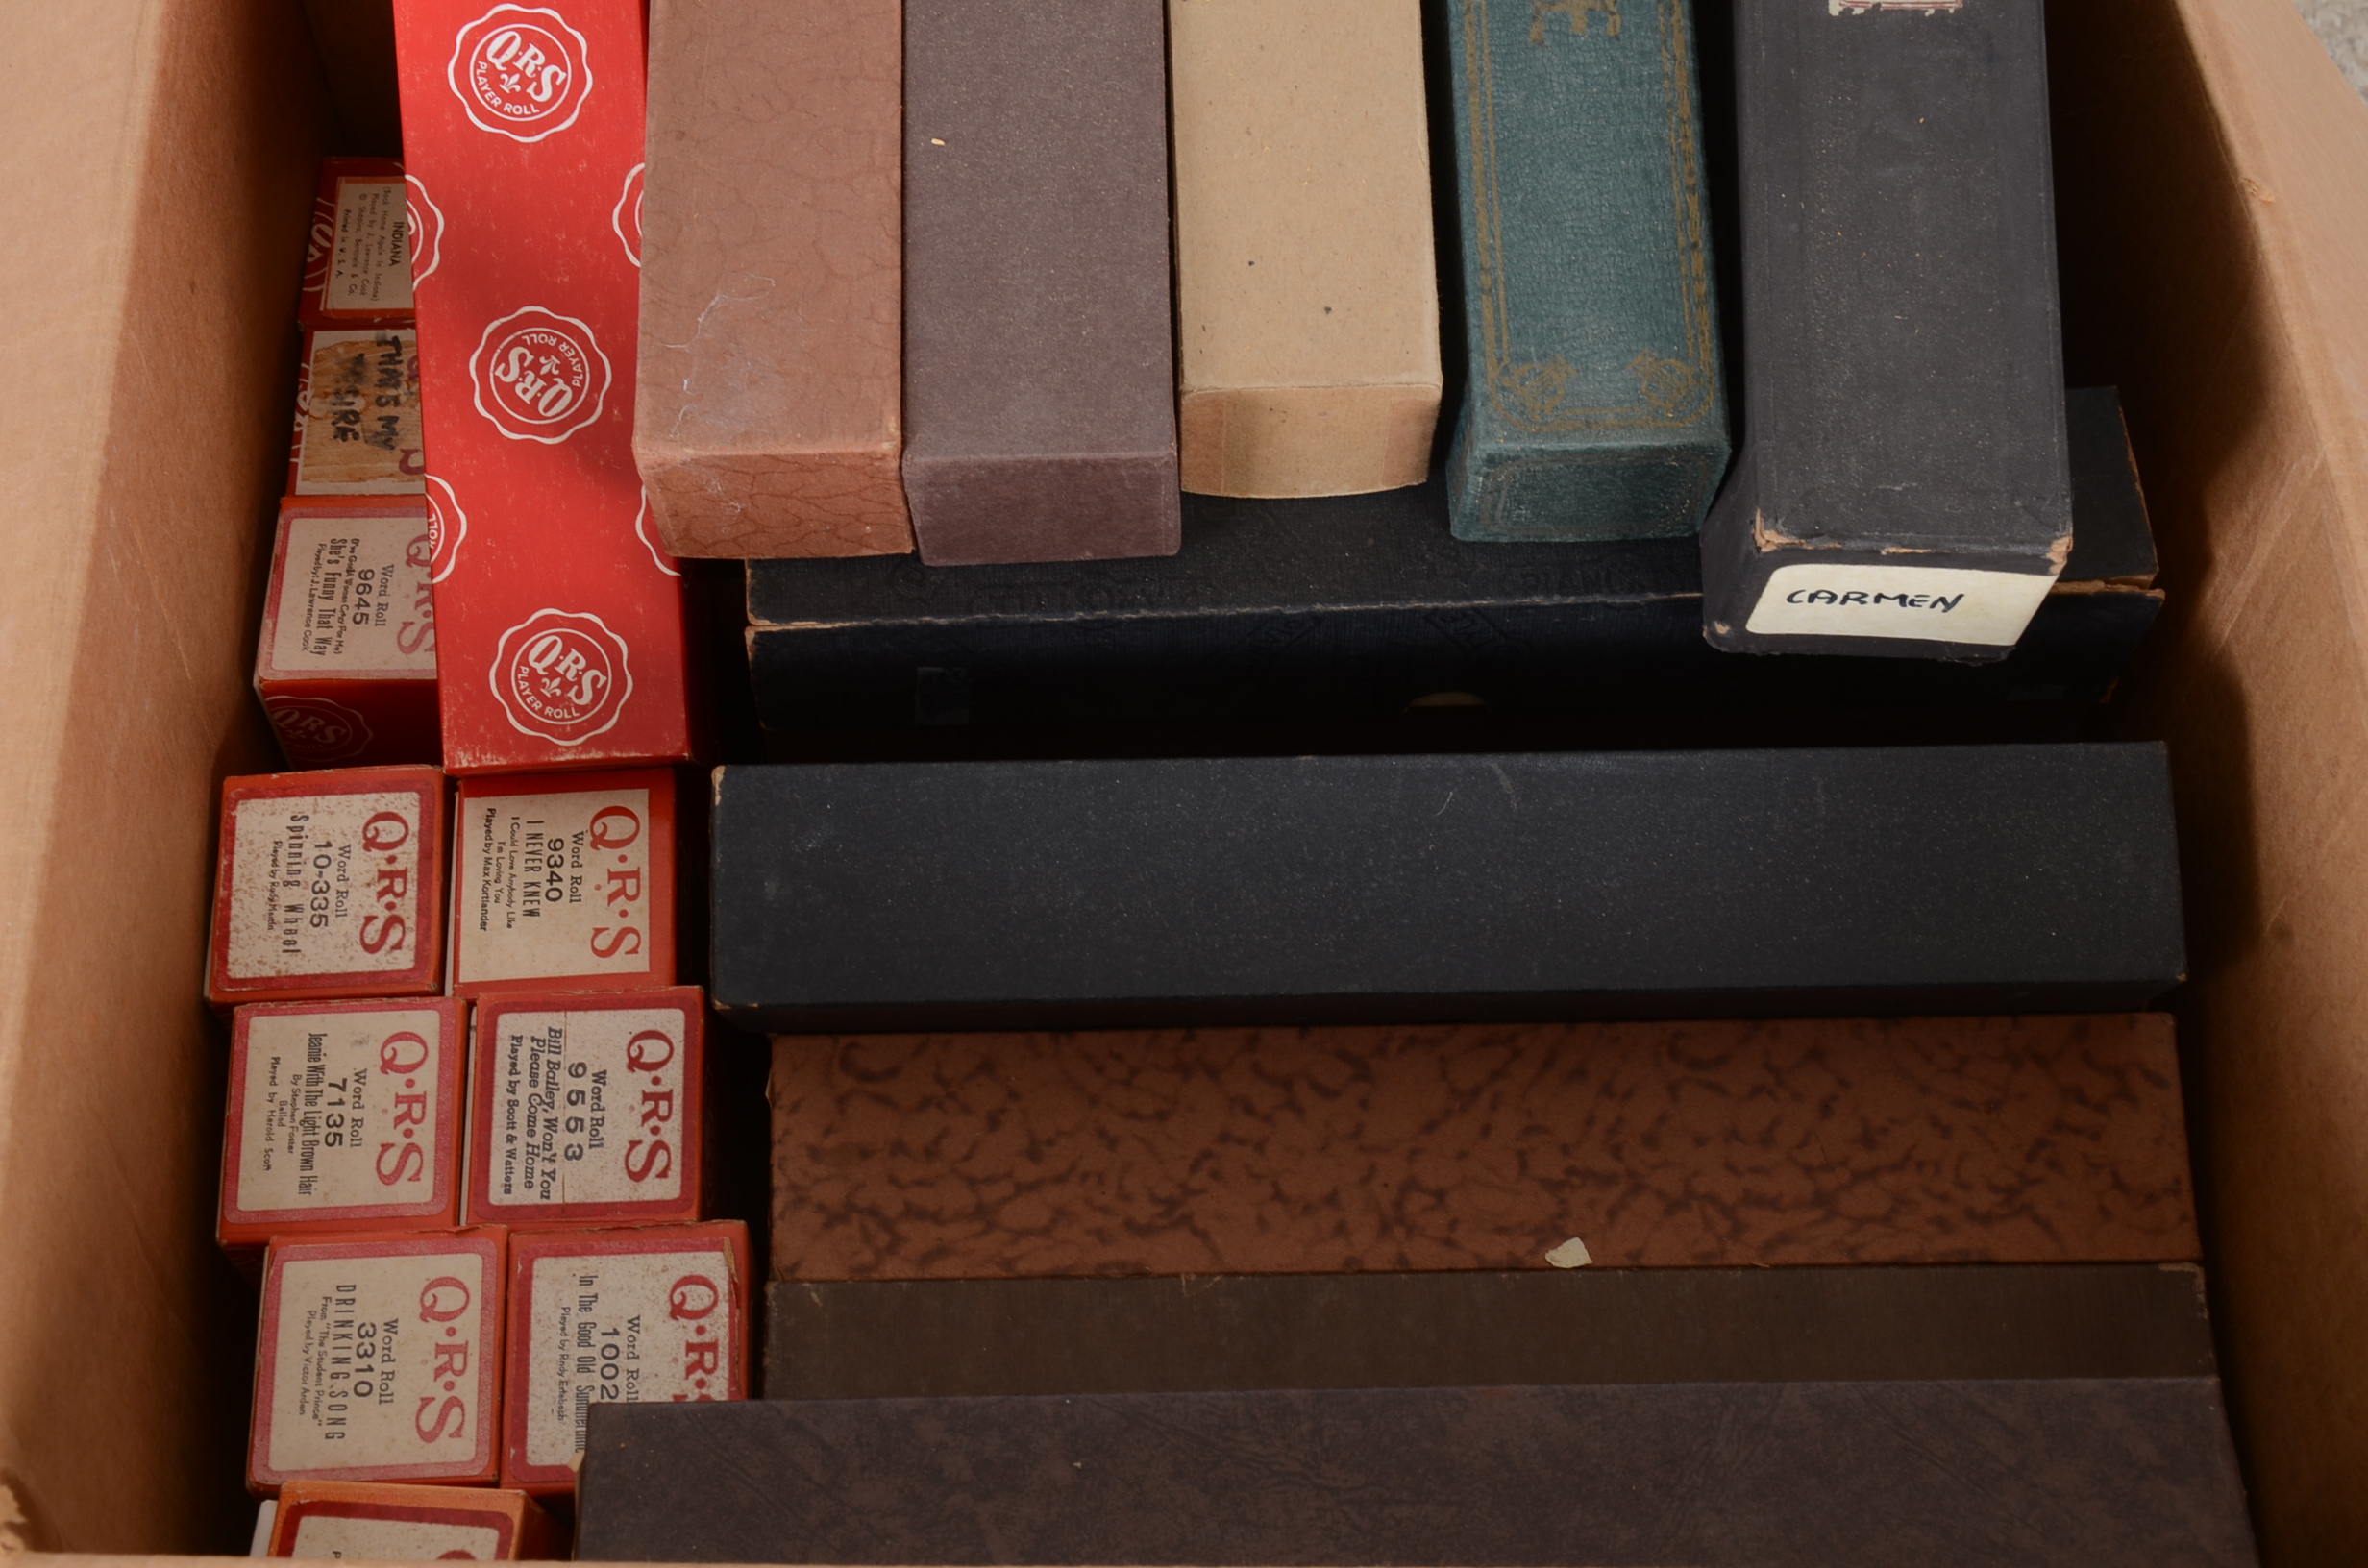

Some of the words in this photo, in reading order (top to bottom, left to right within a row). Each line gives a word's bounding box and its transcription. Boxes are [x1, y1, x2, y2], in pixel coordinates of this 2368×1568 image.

[477, 61, 502, 107] PLAYER
[504, 103, 540, 115] ROLL
[369, 193, 379, 215] Played
[341, 208, 351, 232] Printed
[368, 219, 376, 228] by
[380, 210, 388, 230] Home
[389, 221, 404, 266] INDIANA
[362, 244, 373, 274] Lawrence
[359, 278, 369, 296] Cook
[522, 334, 557, 345] ROLL
[559, 342, 583, 387] PLAYER
[327, 538, 348, 565] She's
[318, 572, 342, 600] Funny
[379, 564, 394, 597] Word
[304, 588, 318, 628] Lawrence
[353, 568, 375, 625] 9645
[1786, 589, 1964, 613] CARMEN
[316, 608, 336, 629] That
[375, 602, 388, 626] Roll
[302, 629, 311, 651] Cook
[309, 637, 333, 655] Way
[337, 625, 347, 638] For
[517, 666, 543, 711] PLAYER
[544, 707, 580, 719] ROLL
[484, 807, 496, 841] Played
[510, 821, 519, 846] Could
[271, 840, 282, 867] Played
[284, 814, 309, 887] Spinning
[482, 841, 493, 854] by
[496, 841, 506, 853] I'm
[508, 849, 517, 870] Love
[524, 832, 543, 872] NEVER
[571, 830, 584, 869] Word
[270, 869, 280, 879] by
[336, 844, 351, 882] Word
[482, 856, 493, 877] Max
[494, 856, 504, 884] Loving
[545, 837, 564, 902] 9340
[310, 840, 332, 928] 10-335
[494, 887, 503, 904] You
[506, 872, 516, 908] Anybody
[569, 875, 582, 904] Roll
[335, 889, 349, 919] Roll
[523, 881, 541, 918] KNEW
[282, 903, 304, 954] Wheel
[308, 1033, 327, 1062] Jeanie
[508, 1034, 523, 1076] Played
[548, 1026, 562, 1055] Bill
[268, 1056, 280, 1086] Played
[305, 1065, 326, 1087] With
[530, 1035, 545, 1088] Please
[291, 1073, 302, 1086] By
[352, 1067, 367, 1110] Word
[506, 1080, 520, 1095] by
[542, 1059, 560, 1113] Bailey,
[591, 1069, 606, 1112] Word
[267, 1091, 278, 1103] by
[288, 1088, 300, 1123] Stephen
[304, 1090, 323, 1107] The
[325, 1077, 347, 1147] 7135
[265, 1110, 276, 1141] Harold
[300, 1110, 321, 1136] Light
[506, 1098, 519, 1131] Scott
[527, 1092, 542, 1138] Come
[287, 1125, 298, 1154] Foster
[350, 1117, 363, 1147] Roll
[506, 1134, 517, 1144] &
[542, 1116, 557, 1164] Won't
[589, 1116, 604, 1149] Roll
[263, 1147, 274, 1171] Scott
[300, 1139, 319, 1171] Brown
[524, 1142, 540, 1189] Home
[298, 1175, 318, 1195] Hair
[504, 1148, 516, 1195] Watters
[540, 1167, 555, 1200] You
[579, 1275, 598, 1286] In
[320, 1295, 332, 1320] From
[578, 1293, 598, 1312] The
[305, 1310, 316, 1340] Played
[330, 1284, 356, 1380] DRINKING
[560, 1306, 571, 1336] Played
[577, 1321, 596, 1348] Good
[303, 1342, 313, 1354] by
[381, 1318, 399, 1362] Word
[559, 1339, 569, 1351] by
[626, 1314, 640, 1360] Word
[301, 1356, 312, 1385] Victor
[315, 1349, 328, 1386] Student
[354, 1322, 377, 1397] 3310
[577, 1355, 596, 1373] Old
[379, 1370, 395, 1405] Roll
[626, 1367, 639, 1402] Roll
[299, 1387, 309, 1415] Arden
[325, 1390, 349, 1440] SONG
